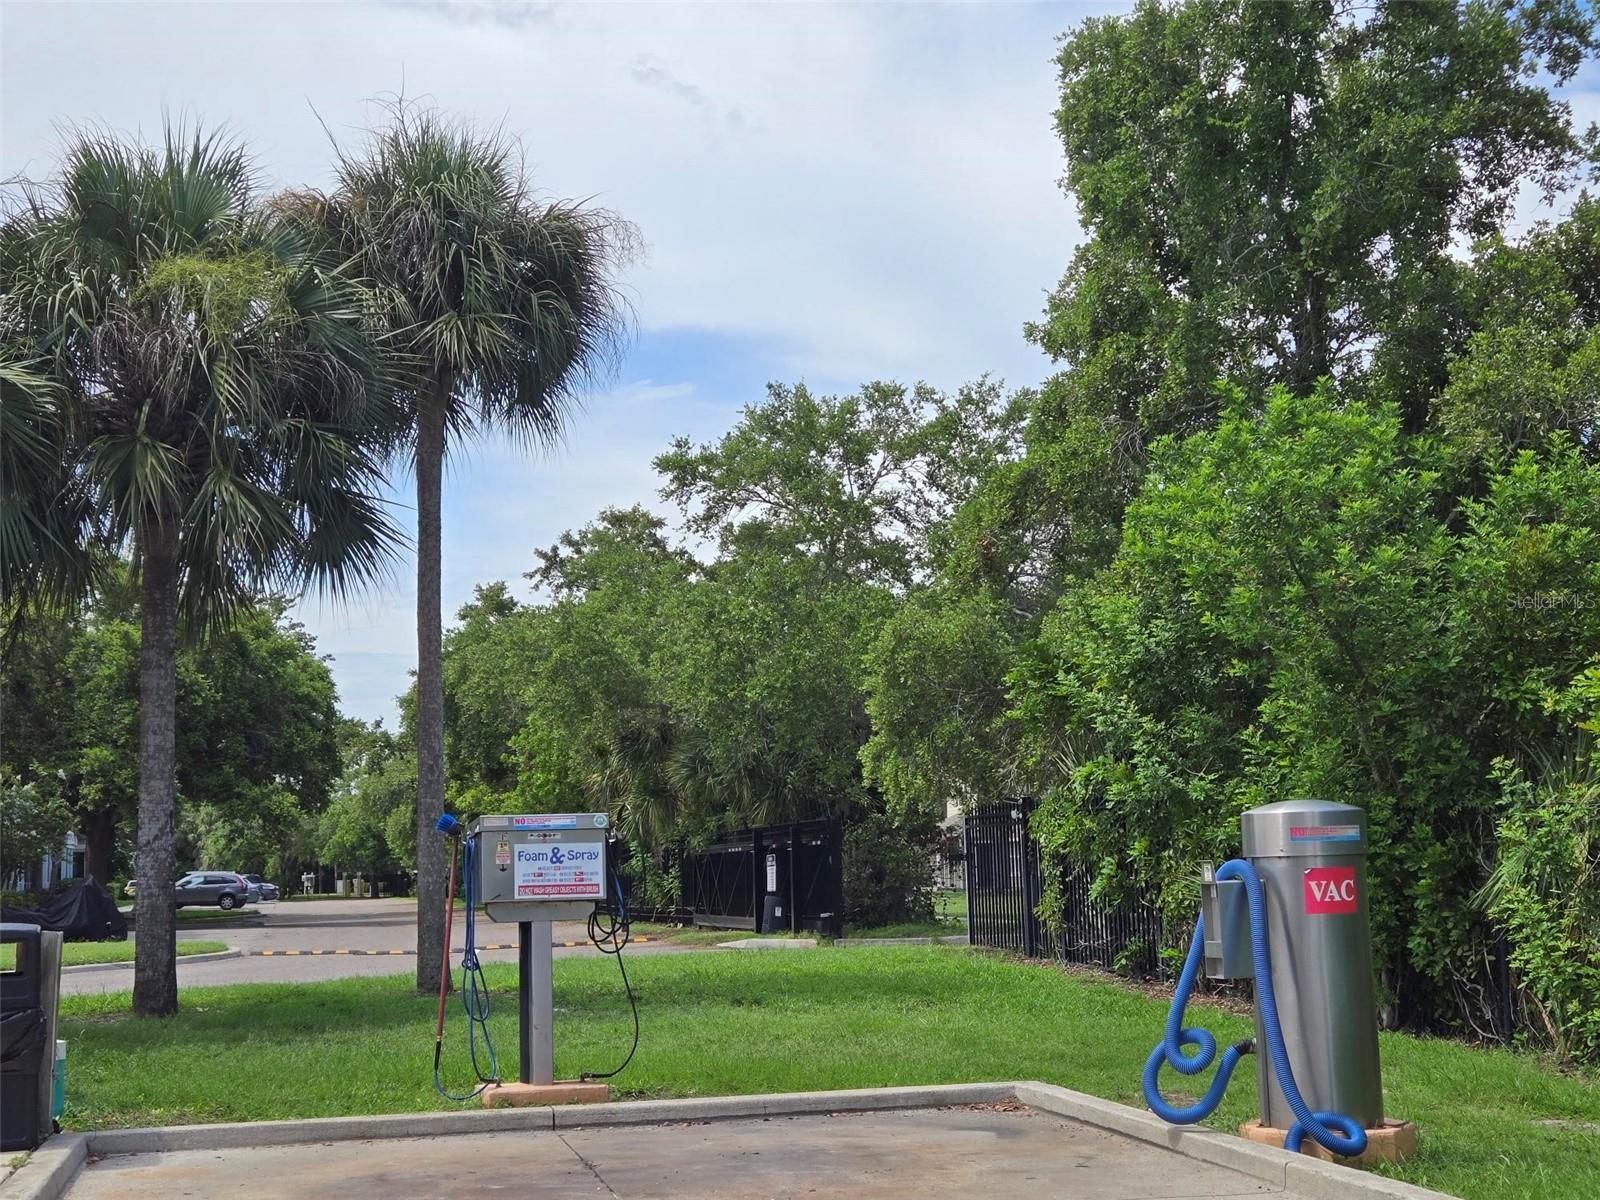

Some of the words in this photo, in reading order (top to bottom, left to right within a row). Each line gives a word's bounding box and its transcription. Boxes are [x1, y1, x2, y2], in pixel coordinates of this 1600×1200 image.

[518, 851, 548, 862] Foam
[549, 847, 565, 864] &
[567, 849, 599, 862] Spray
[519, 887, 526, 895] DO
[545, 886, 560, 894] GREASY
[586, 885, 599, 893] BRUSH
[1309, 880, 1355, 902] VAC
